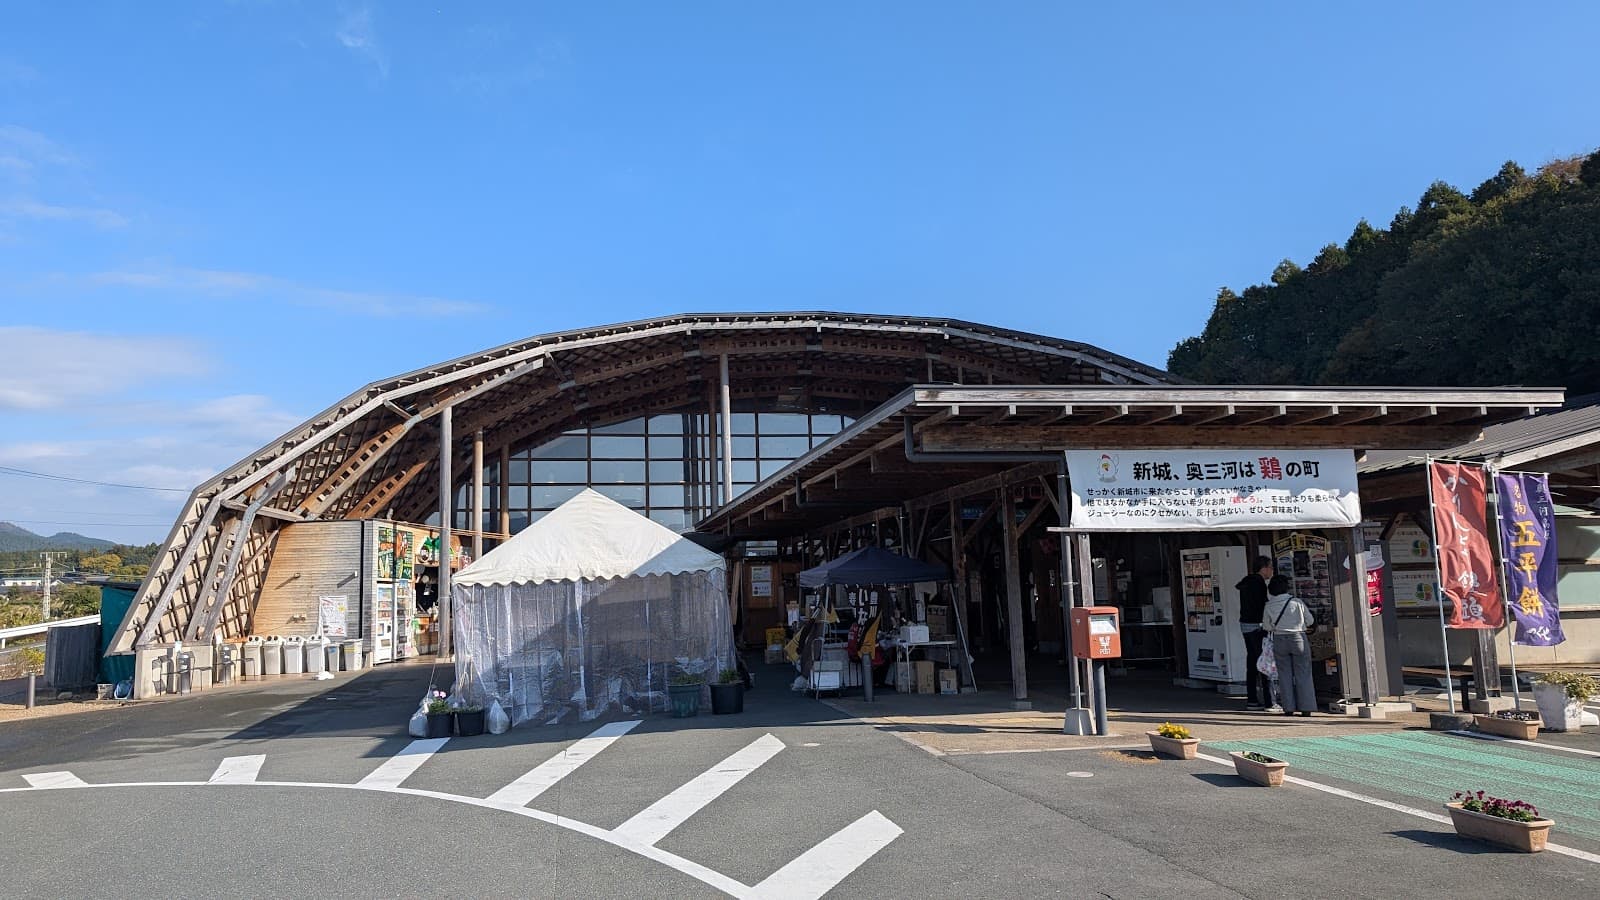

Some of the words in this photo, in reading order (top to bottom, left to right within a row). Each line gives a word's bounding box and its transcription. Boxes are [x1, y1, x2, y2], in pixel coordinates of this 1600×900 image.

[1132, 456, 1320, 481] 新城、奥三河は鶏の町
